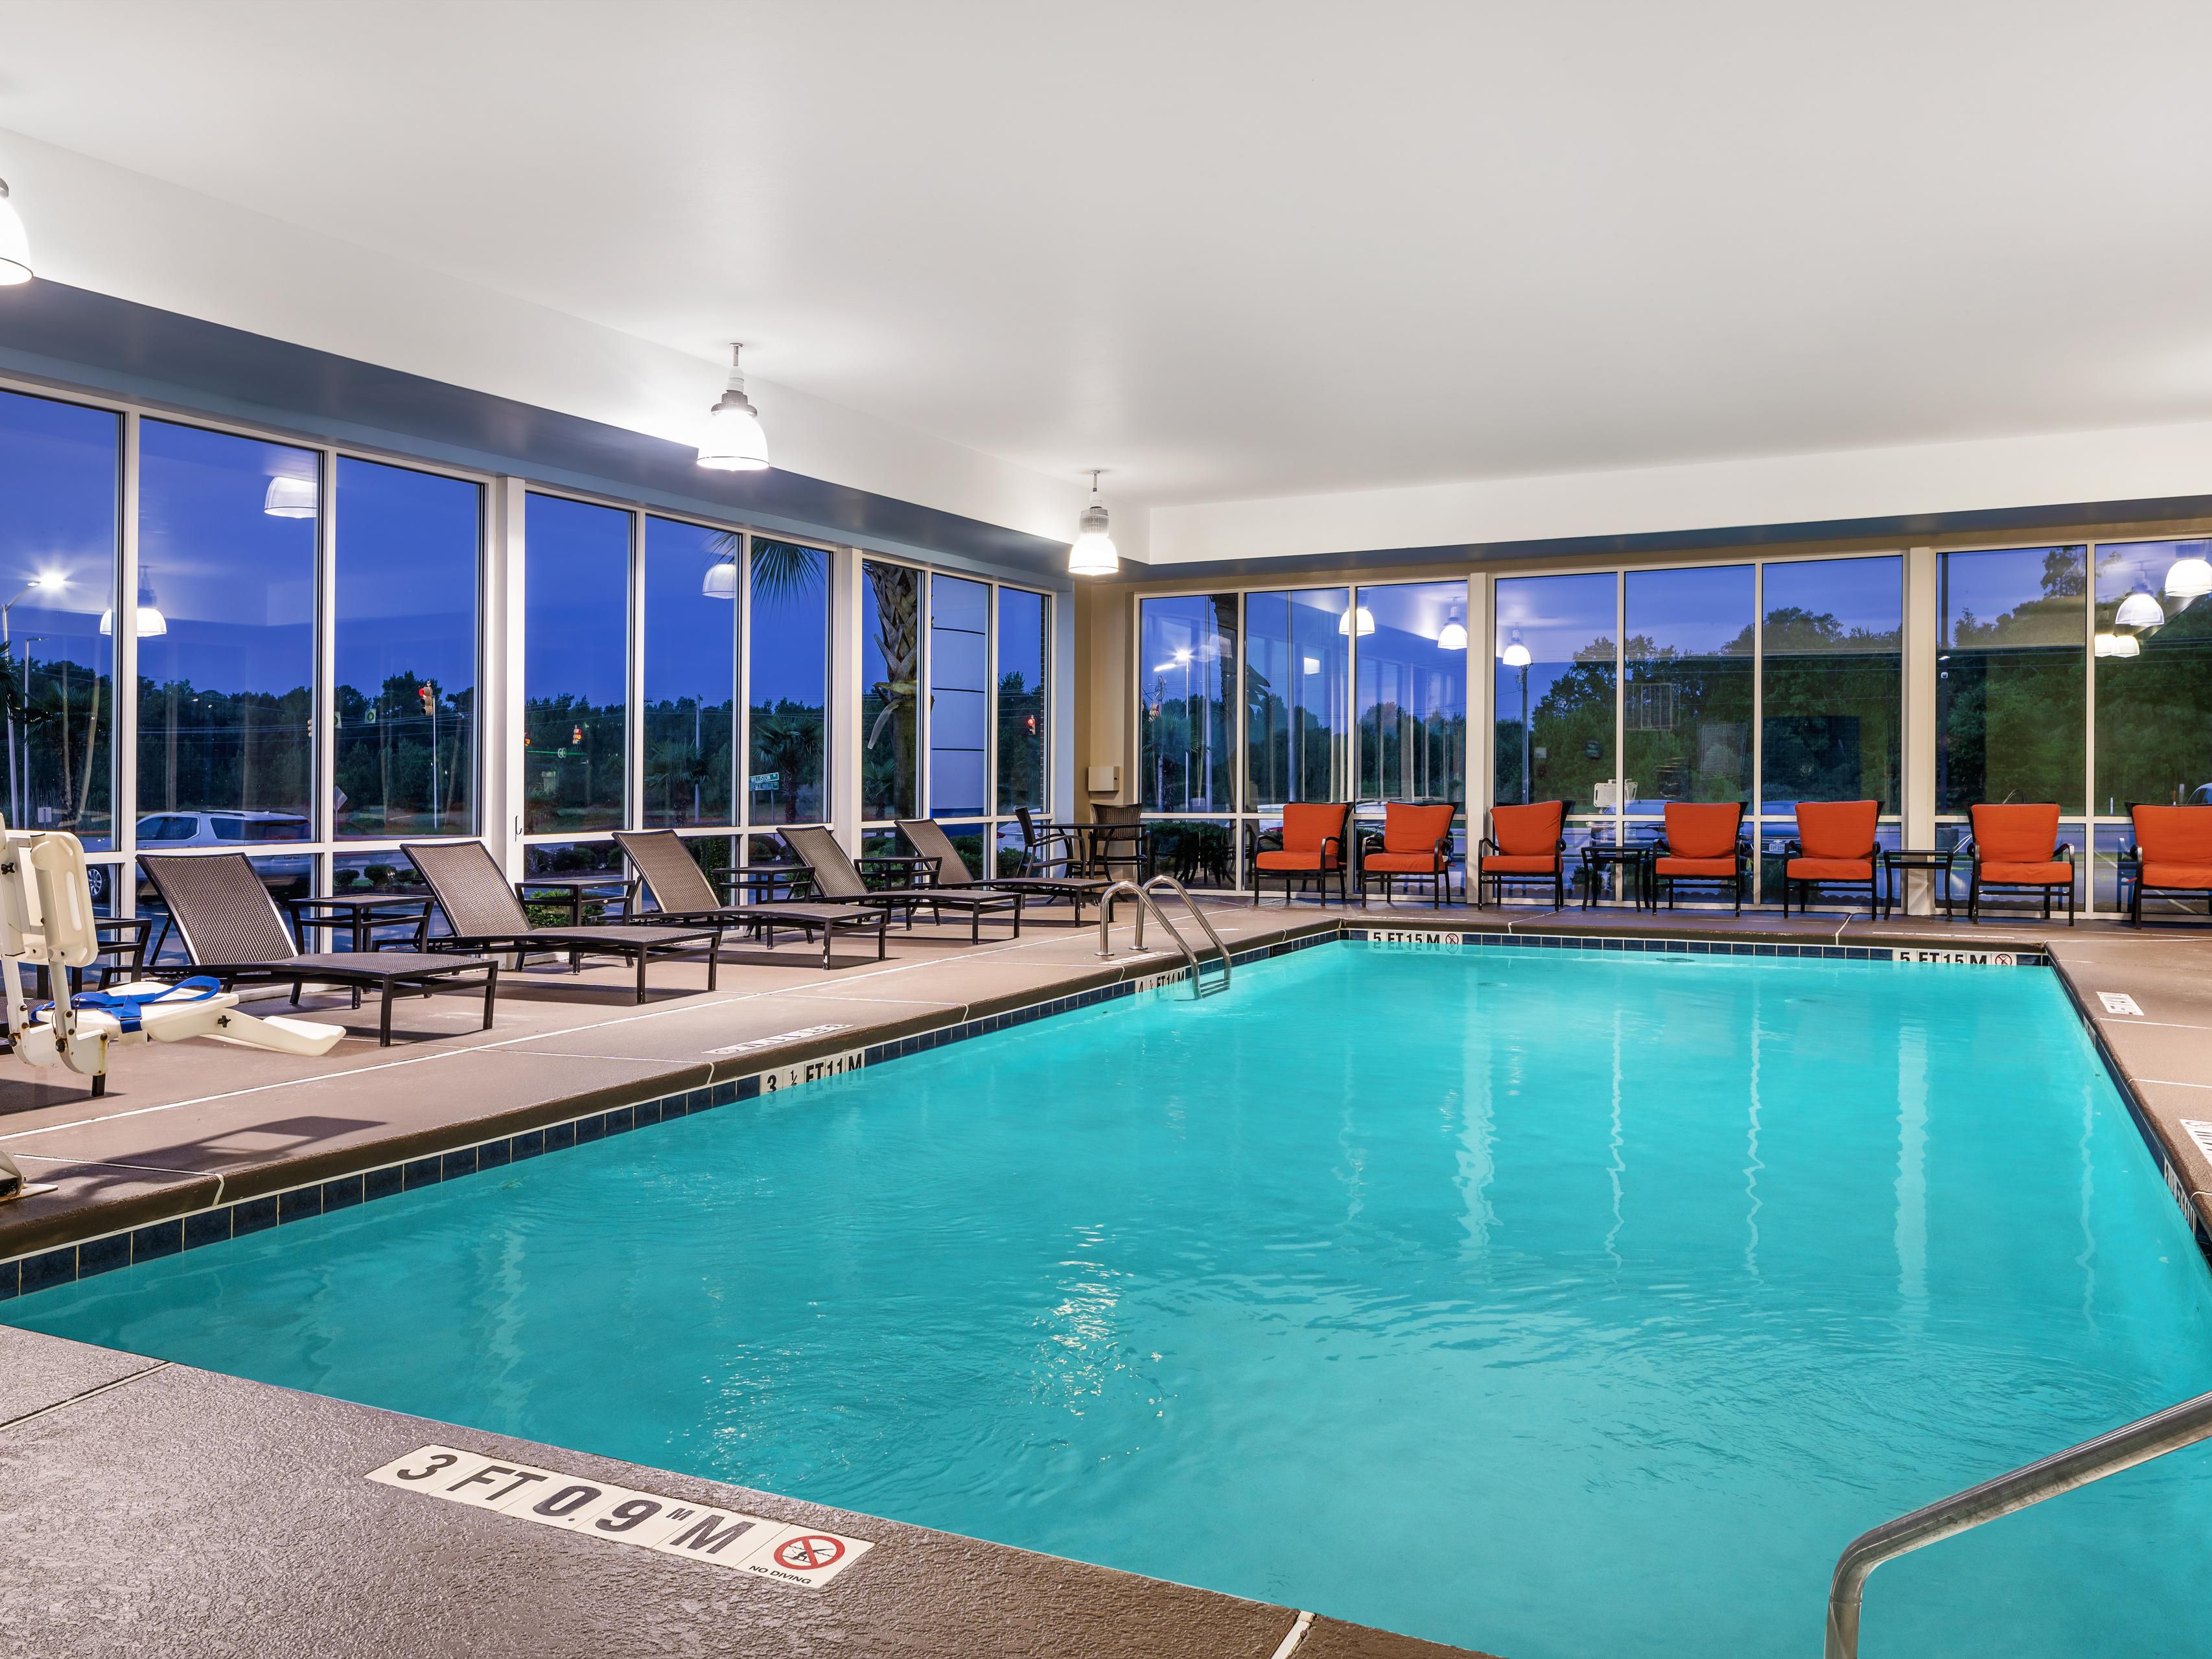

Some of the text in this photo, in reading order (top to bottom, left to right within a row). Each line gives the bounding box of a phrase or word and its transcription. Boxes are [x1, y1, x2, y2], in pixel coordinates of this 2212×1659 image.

[1373, 932, 1382, 942] 5
[1388, 933, 1404, 943] FT
[1426, 934, 1440, 944] M
[1900, 952, 1910, 962] 5
[1918, 952, 1940, 963] FT
[1970, 955, 1987, 964] M
[1178, 971, 1185, 983] M
[767, 1074, 777, 1093] 3
[806, 1062, 824, 1083] FT
[848, 1053, 862, 1071] M
[397, 1454, 458, 1480] 3
[445, 1465, 550, 1501] FT
[669, 1514, 757, 1555] M
[749, 1565, 812, 1584] NO DIVING
